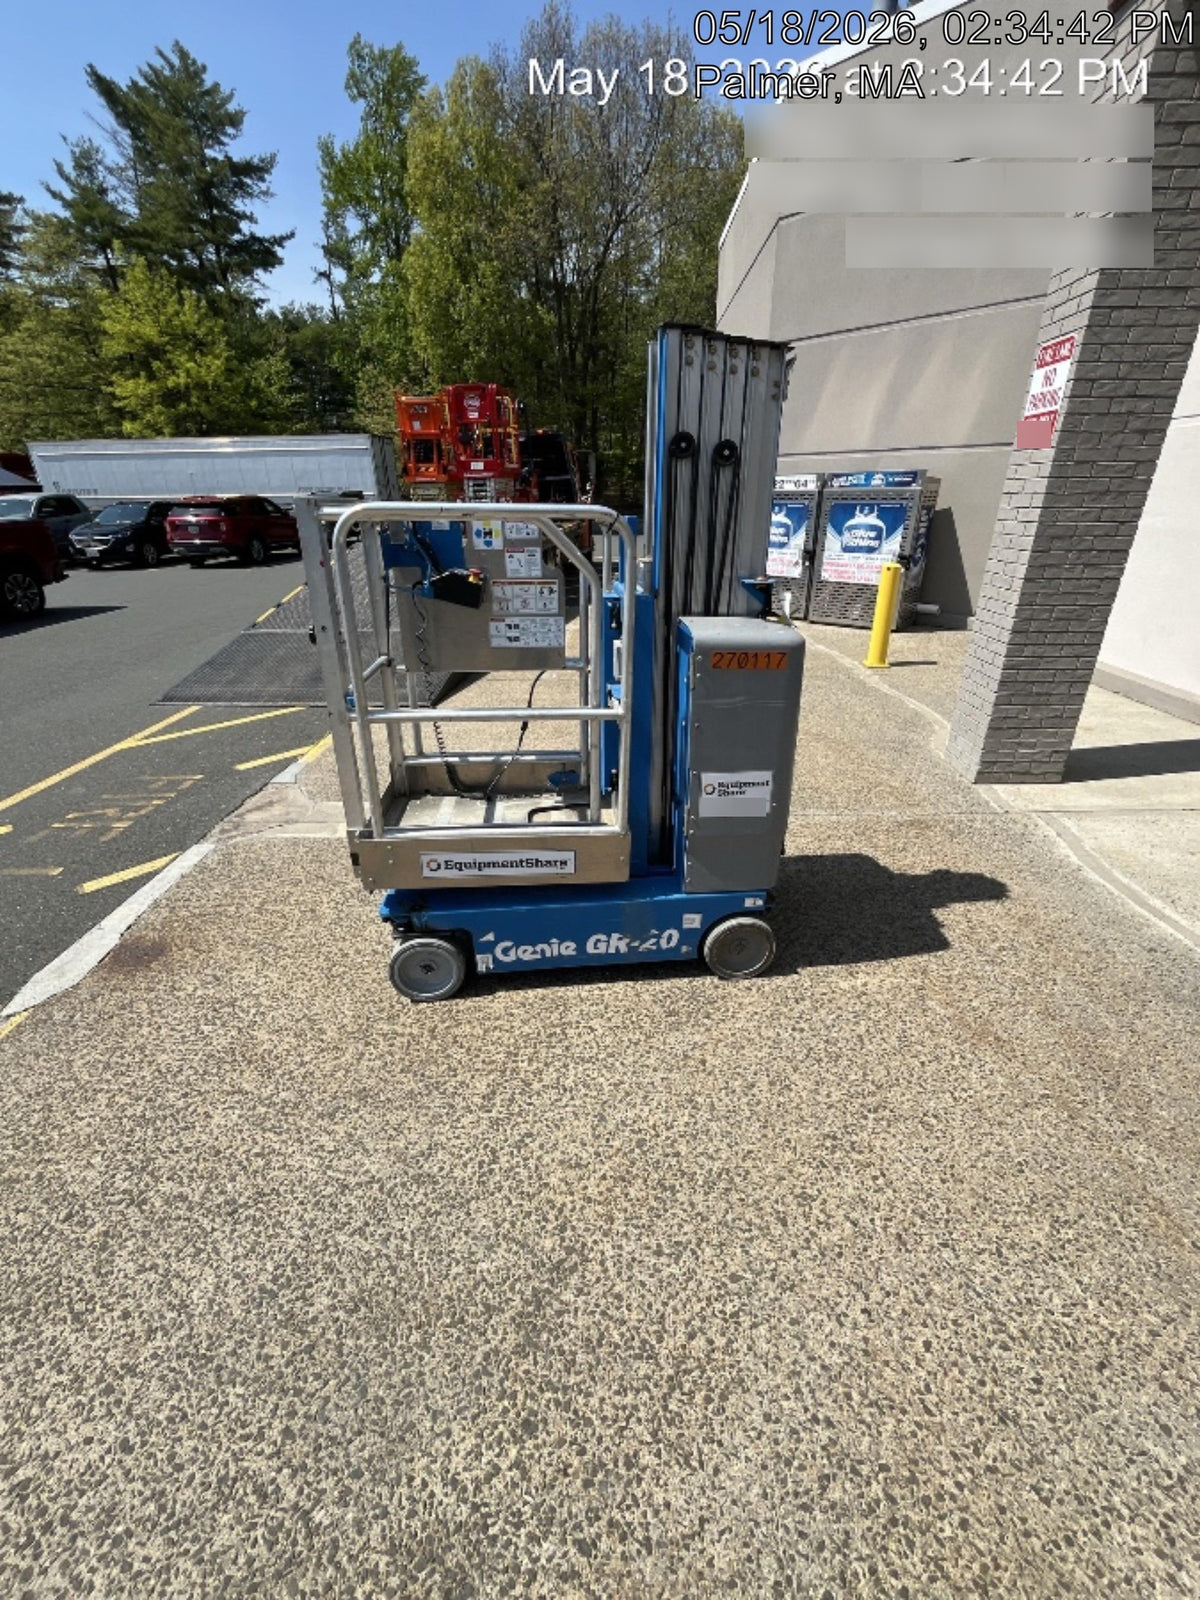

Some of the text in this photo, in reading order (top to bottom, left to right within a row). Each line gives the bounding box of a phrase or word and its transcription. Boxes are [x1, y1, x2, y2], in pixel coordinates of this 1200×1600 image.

[1042, 367, 1057, 388] NO
[711, 652, 787, 669] 270117
[717, 780, 770, 791] Equipment
[444, 858, 568, 872] EquipmentShare
[494, 938, 577, 962] Genie
